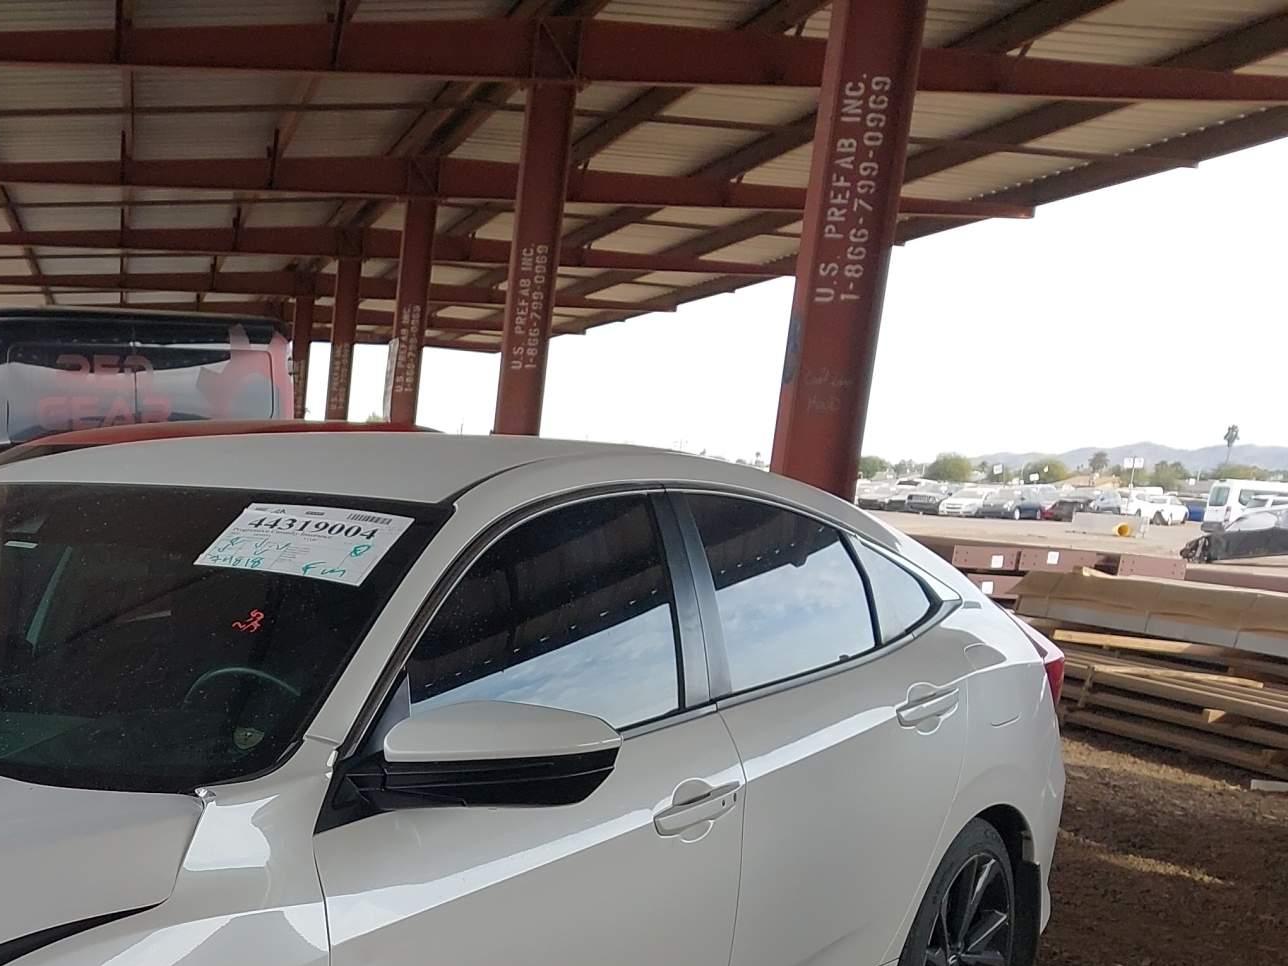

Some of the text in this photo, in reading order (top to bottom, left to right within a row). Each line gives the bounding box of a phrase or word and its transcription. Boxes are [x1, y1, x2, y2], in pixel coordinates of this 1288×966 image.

[815, 73, 868, 302] U.S. PREFAB INC.
[840, 76, 892, 301] 1-866-799-0969
[514, 278, 531, 335] PREFAB
[524, 244, 549, 368] 1-866-799-0969
[511, 342, 525, 369] U.S.
[248, 516, 379, 541] 44319004
